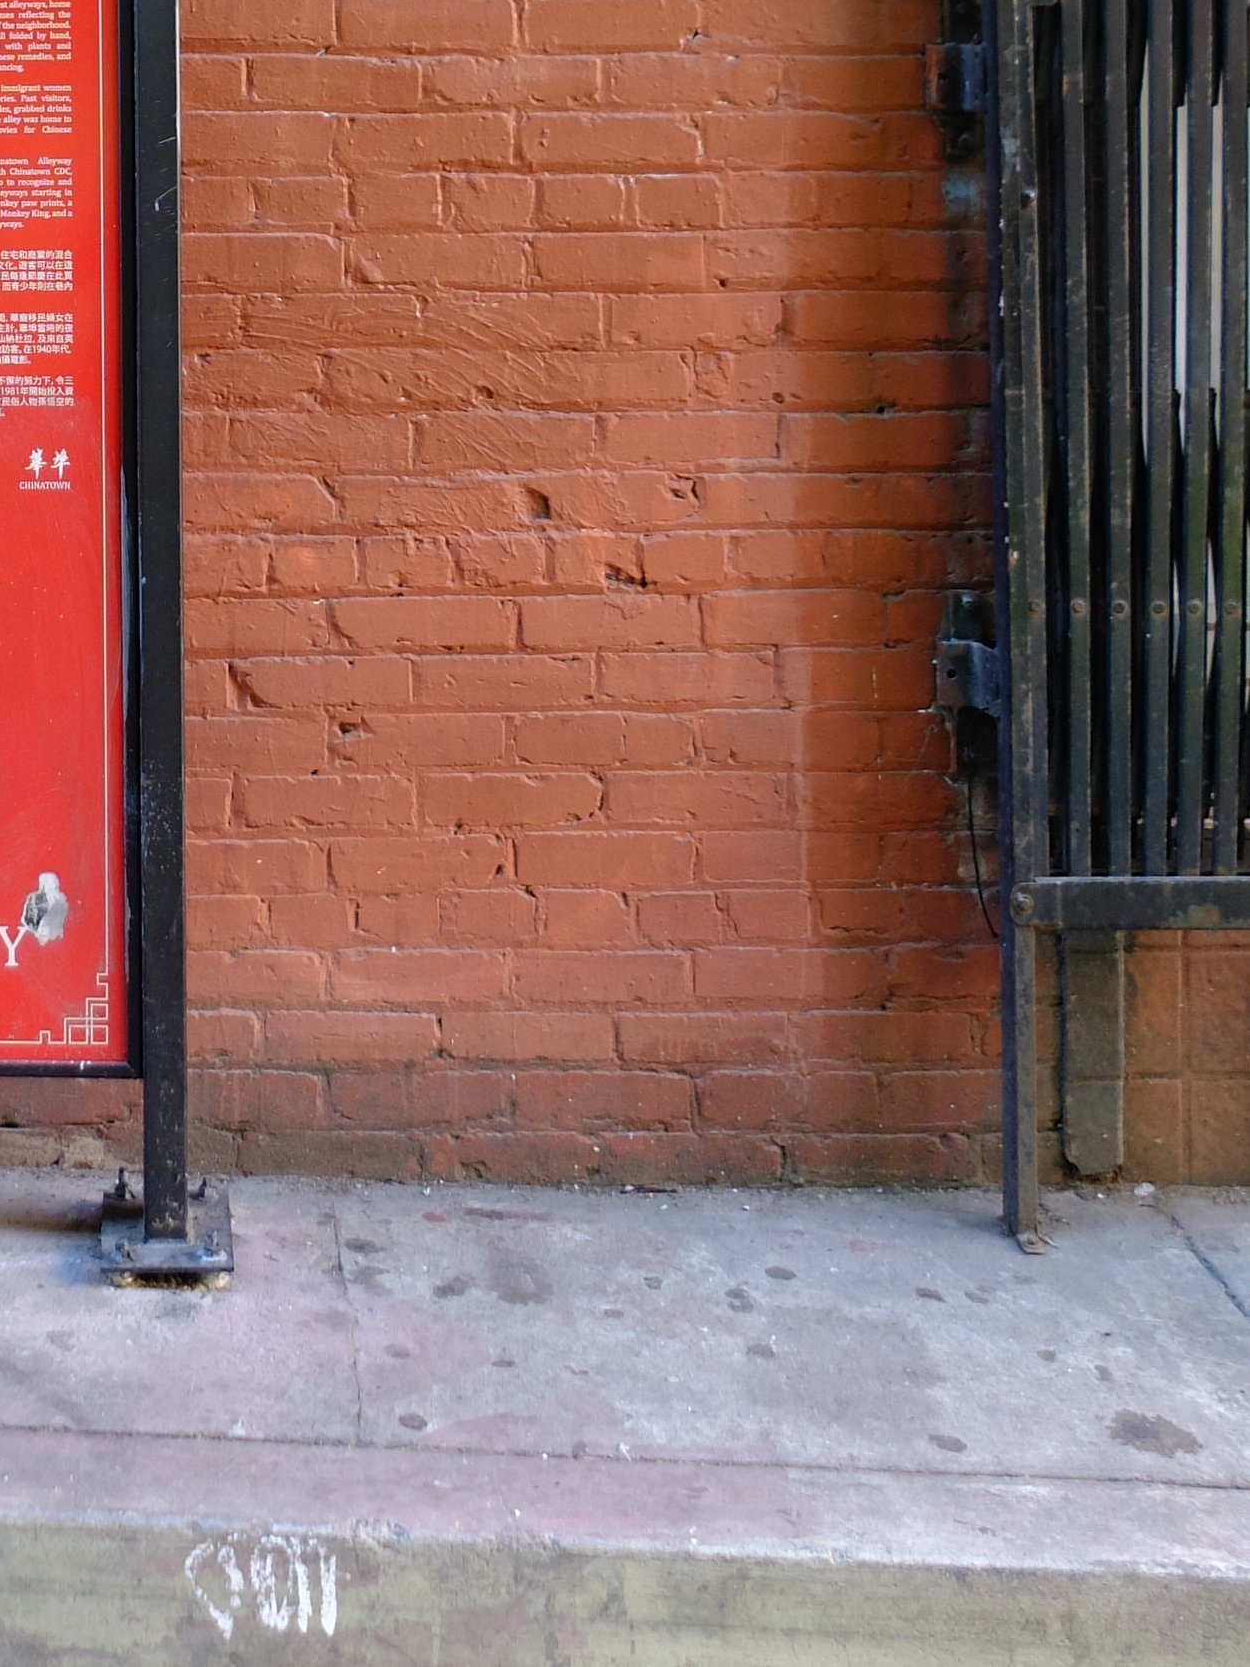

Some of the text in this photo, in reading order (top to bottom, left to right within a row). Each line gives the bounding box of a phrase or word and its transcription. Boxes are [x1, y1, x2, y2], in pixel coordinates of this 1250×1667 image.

[49, 0, 70, 9] home
[18, 10, 54, 21] reflecting
[58, 10, 71, 19] the
[2, 21, 15, 30] the
[9, 31, 33, 41] folded
[37, 31, 46, 42] by
[5, 42, 22, 51] with
[28, 42, 51, 52] plants
[56, 42, 71, 51] and
[57, 52, 71, 61] and
[1, 84, 41, 94] immigrant
[43, 85, 71, 93] women
[21, 94, 37, 103] Past
[14, 104, 45, 115] grabbed
[47, 104, 71, 113] drinks
[24, 125, 35, 135] for
[42, 125, 72, 135] Chinese
[38, 157, 72, 167] Alleyway
[9, 167, 51, 176] Chinatown
[7, 178, 15, 187] to
[18, 178, 54, 188] recognize
[57, 178, 72, 187] and
[31, 188, 61, 199] starting
[64, 188, 72, 197] in
[21, 200, 37, 209] paw
[0, 209, 30, 220] Monkey
[52, 209, 66, 218] and
[19, 481, 71, 490] CHINATOWN
